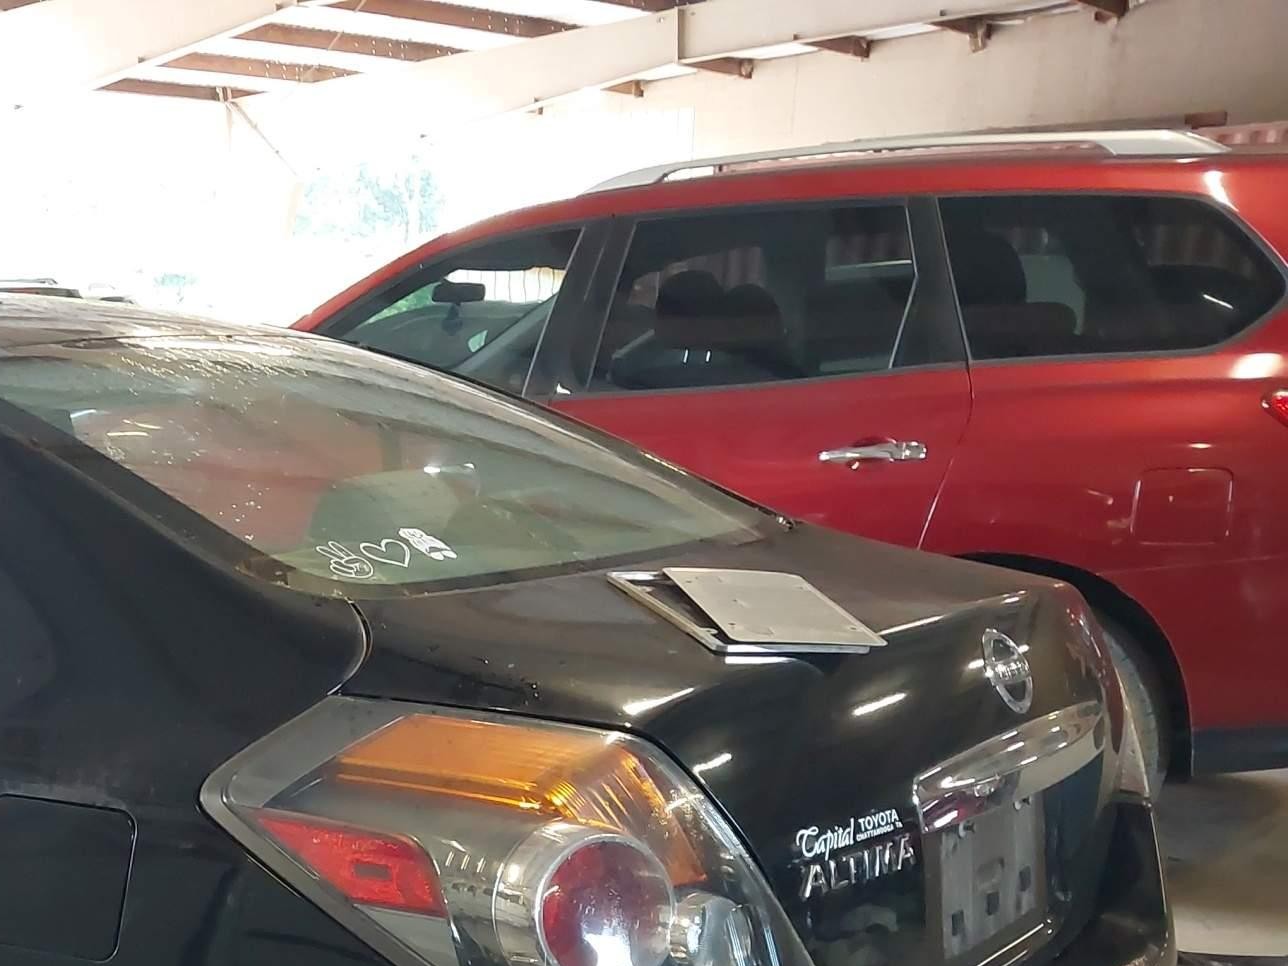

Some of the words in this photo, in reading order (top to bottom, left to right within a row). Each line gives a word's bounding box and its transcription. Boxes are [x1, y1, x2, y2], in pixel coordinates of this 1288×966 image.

[796, 817, 855, 861] Capital
[858, 808, 900, 832] TOYOTA
[801, 833, 917, 900] ALTIMA
